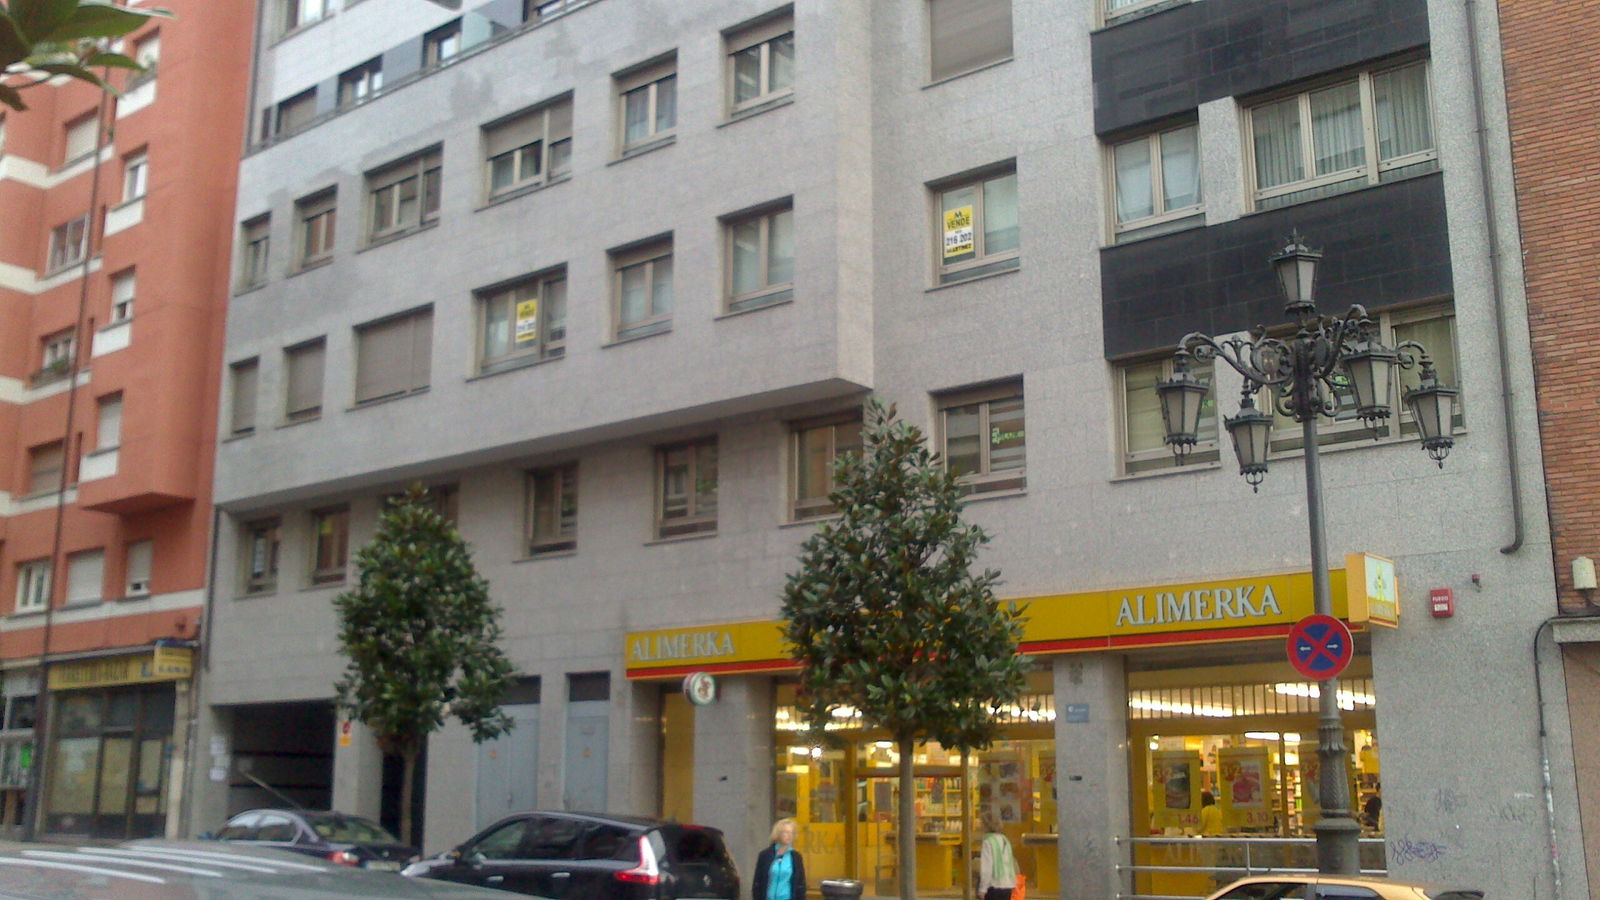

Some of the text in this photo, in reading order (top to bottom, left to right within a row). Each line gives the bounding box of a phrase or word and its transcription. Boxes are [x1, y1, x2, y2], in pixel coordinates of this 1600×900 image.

[946, 216, 970, 230] VENDE
[1115, 583, 1282, 627] ALIMERKA
[631, 631, 736, 662] ALIMERKA
